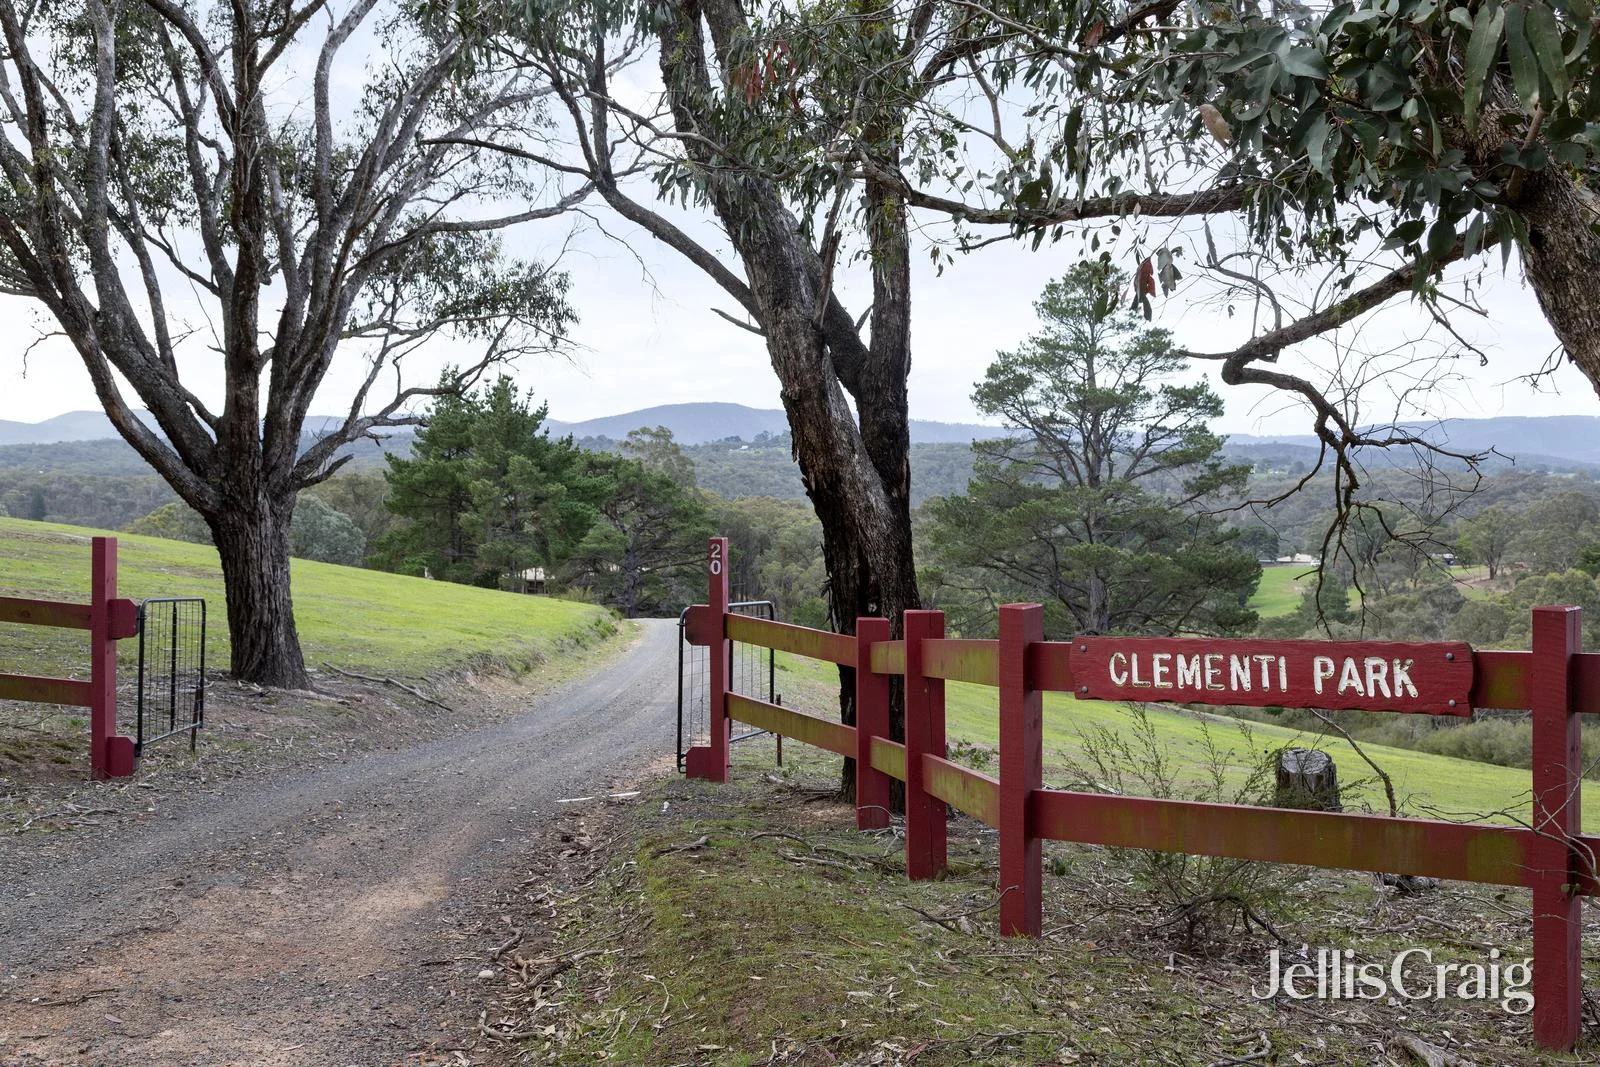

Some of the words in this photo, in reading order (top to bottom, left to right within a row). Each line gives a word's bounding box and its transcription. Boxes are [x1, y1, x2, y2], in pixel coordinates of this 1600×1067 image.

[710, 543, 721, 575] 20
[1108, 652, 1288, 692] CLEMENTI
[1313, 655, 1419, 699] PARK
